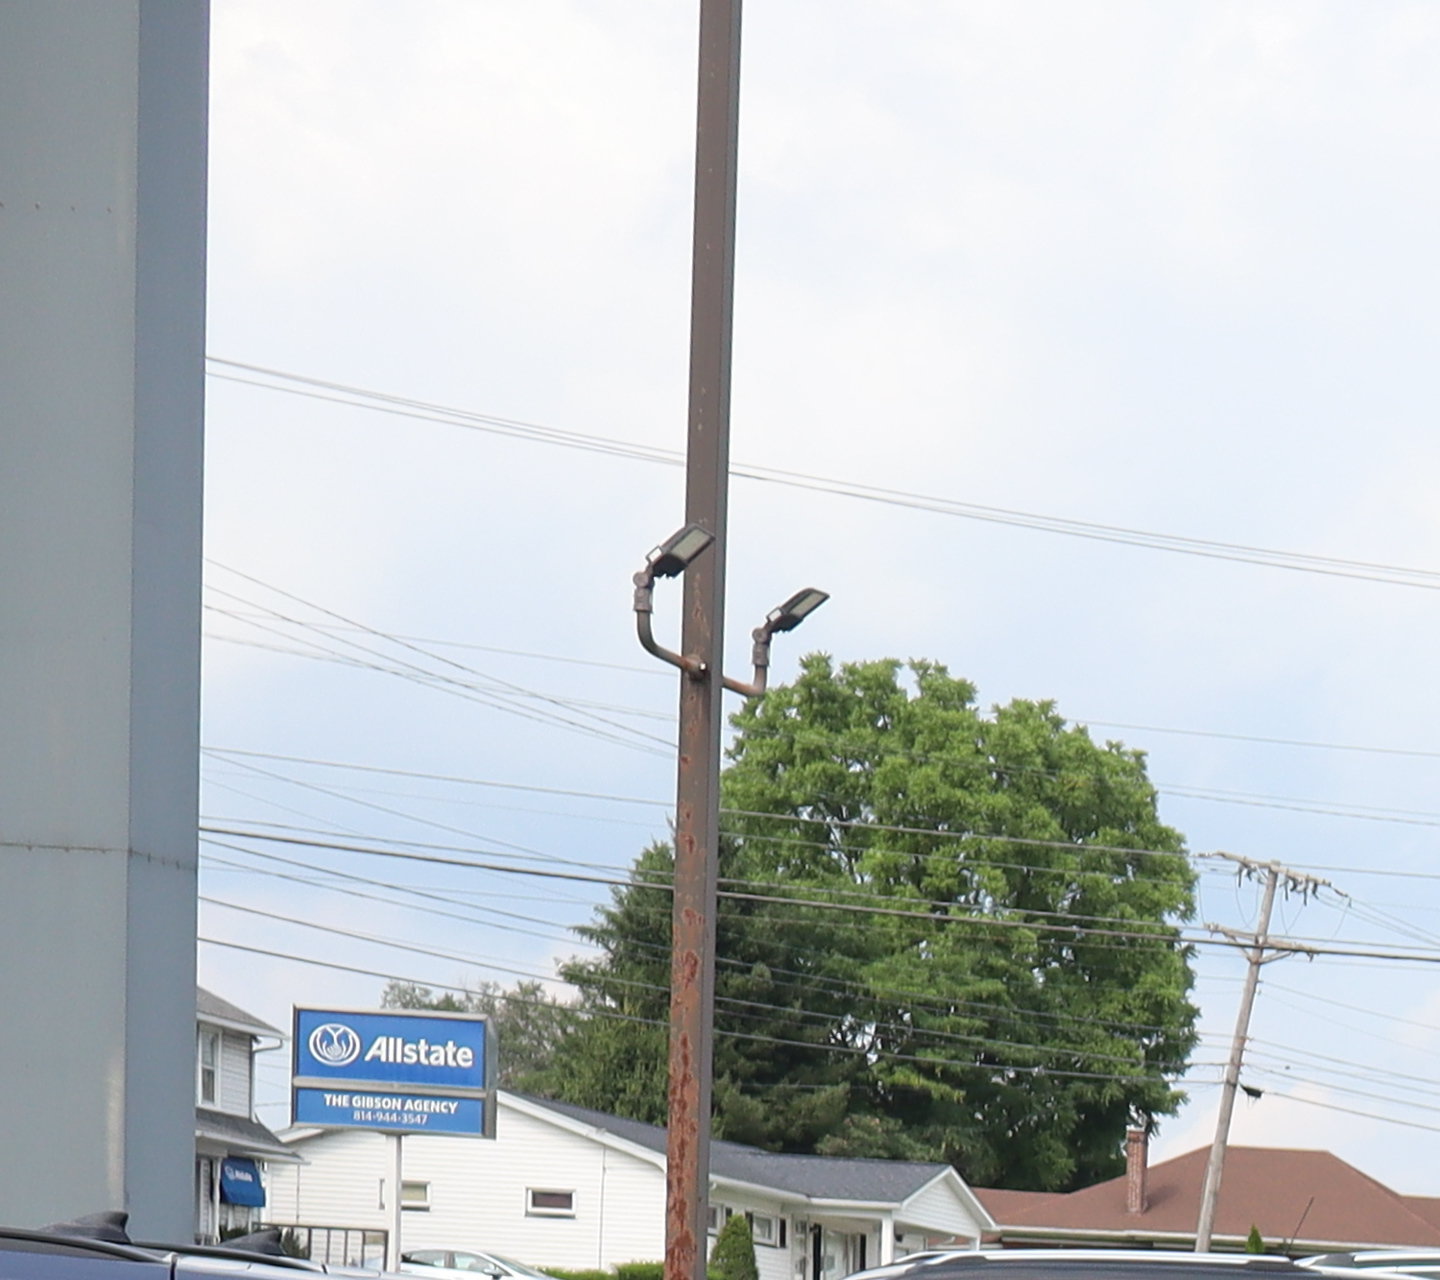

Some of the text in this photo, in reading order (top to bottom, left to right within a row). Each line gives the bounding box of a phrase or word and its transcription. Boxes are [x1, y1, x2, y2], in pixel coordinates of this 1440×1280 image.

[364, 1036, 474, 1068] Allstate
[324, 1094, 458, 1114] THE GIBSON AGENCY
